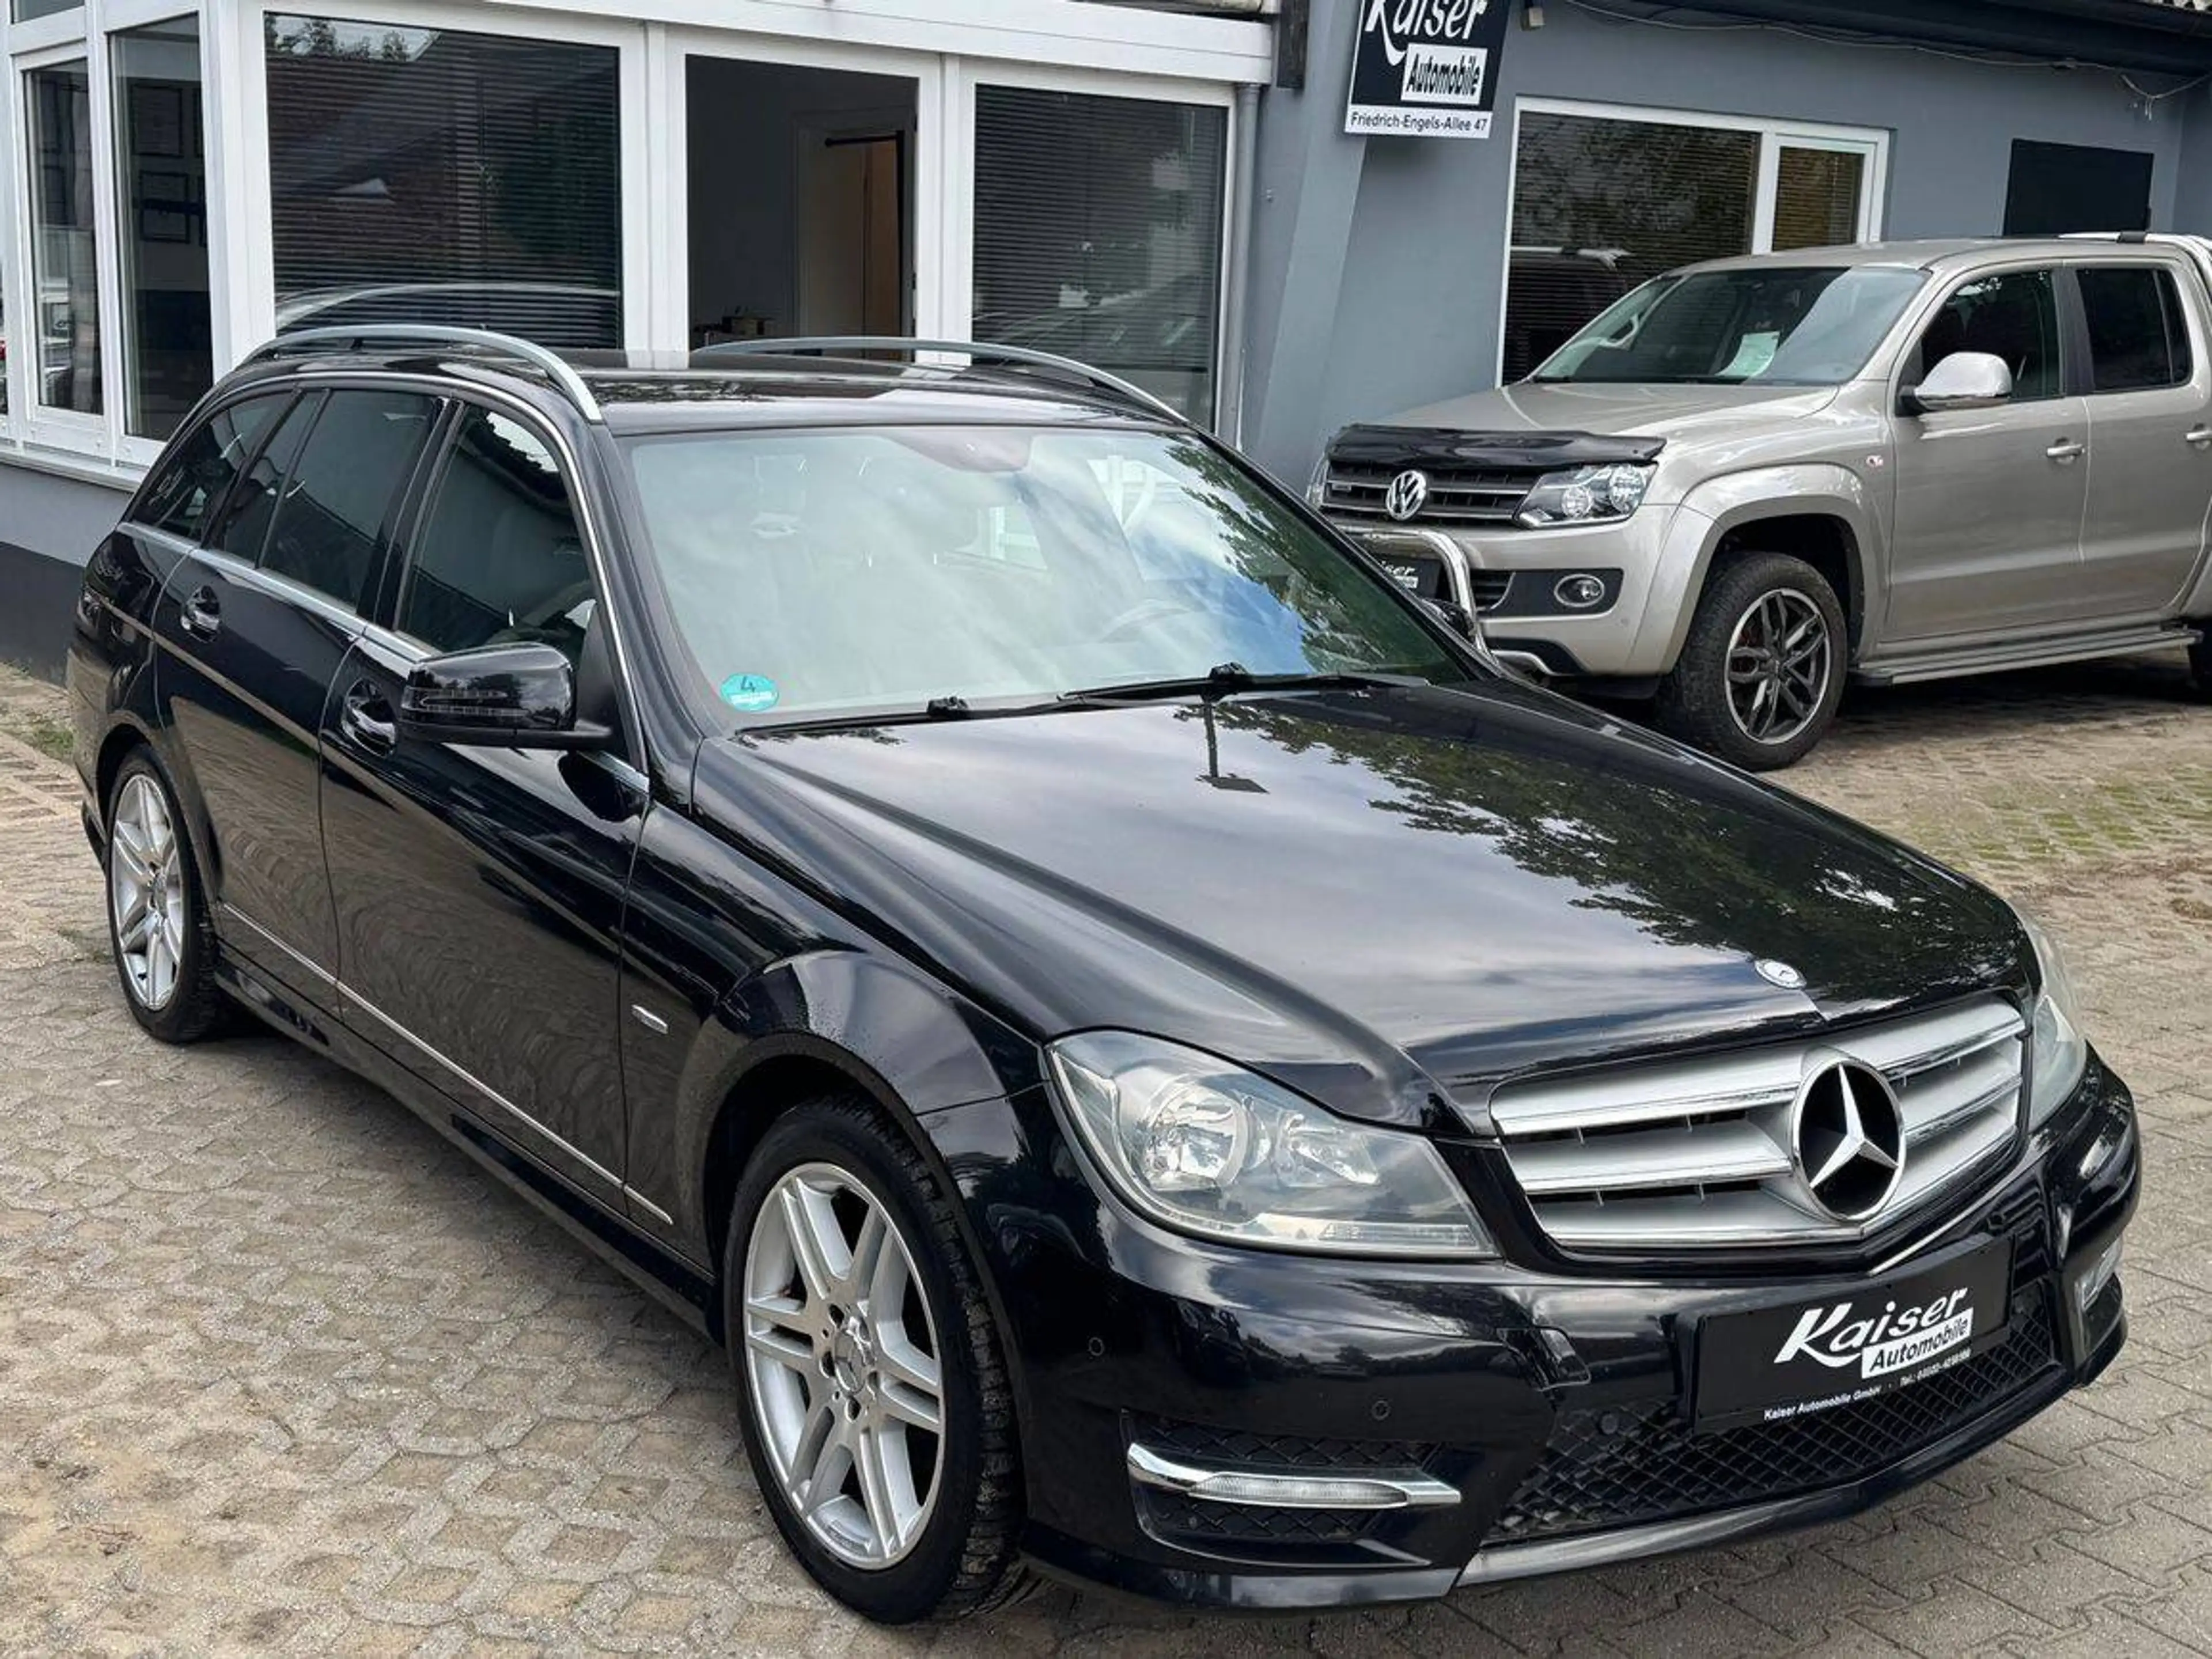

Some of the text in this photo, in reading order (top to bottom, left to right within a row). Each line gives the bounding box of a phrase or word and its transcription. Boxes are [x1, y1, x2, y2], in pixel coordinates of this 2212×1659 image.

[1365, 0, 1488, 66] Kaiser
[1406, 53, 1480, 96] Automobile
[1351, 111, 1488, 132] Friedrich-Engels-Allee 47
[741, 675, 756, 692] 4
[1774, 1287, 1968, 1368] Kaiser
[1869, 1317, 1968, 1373] Automobile
